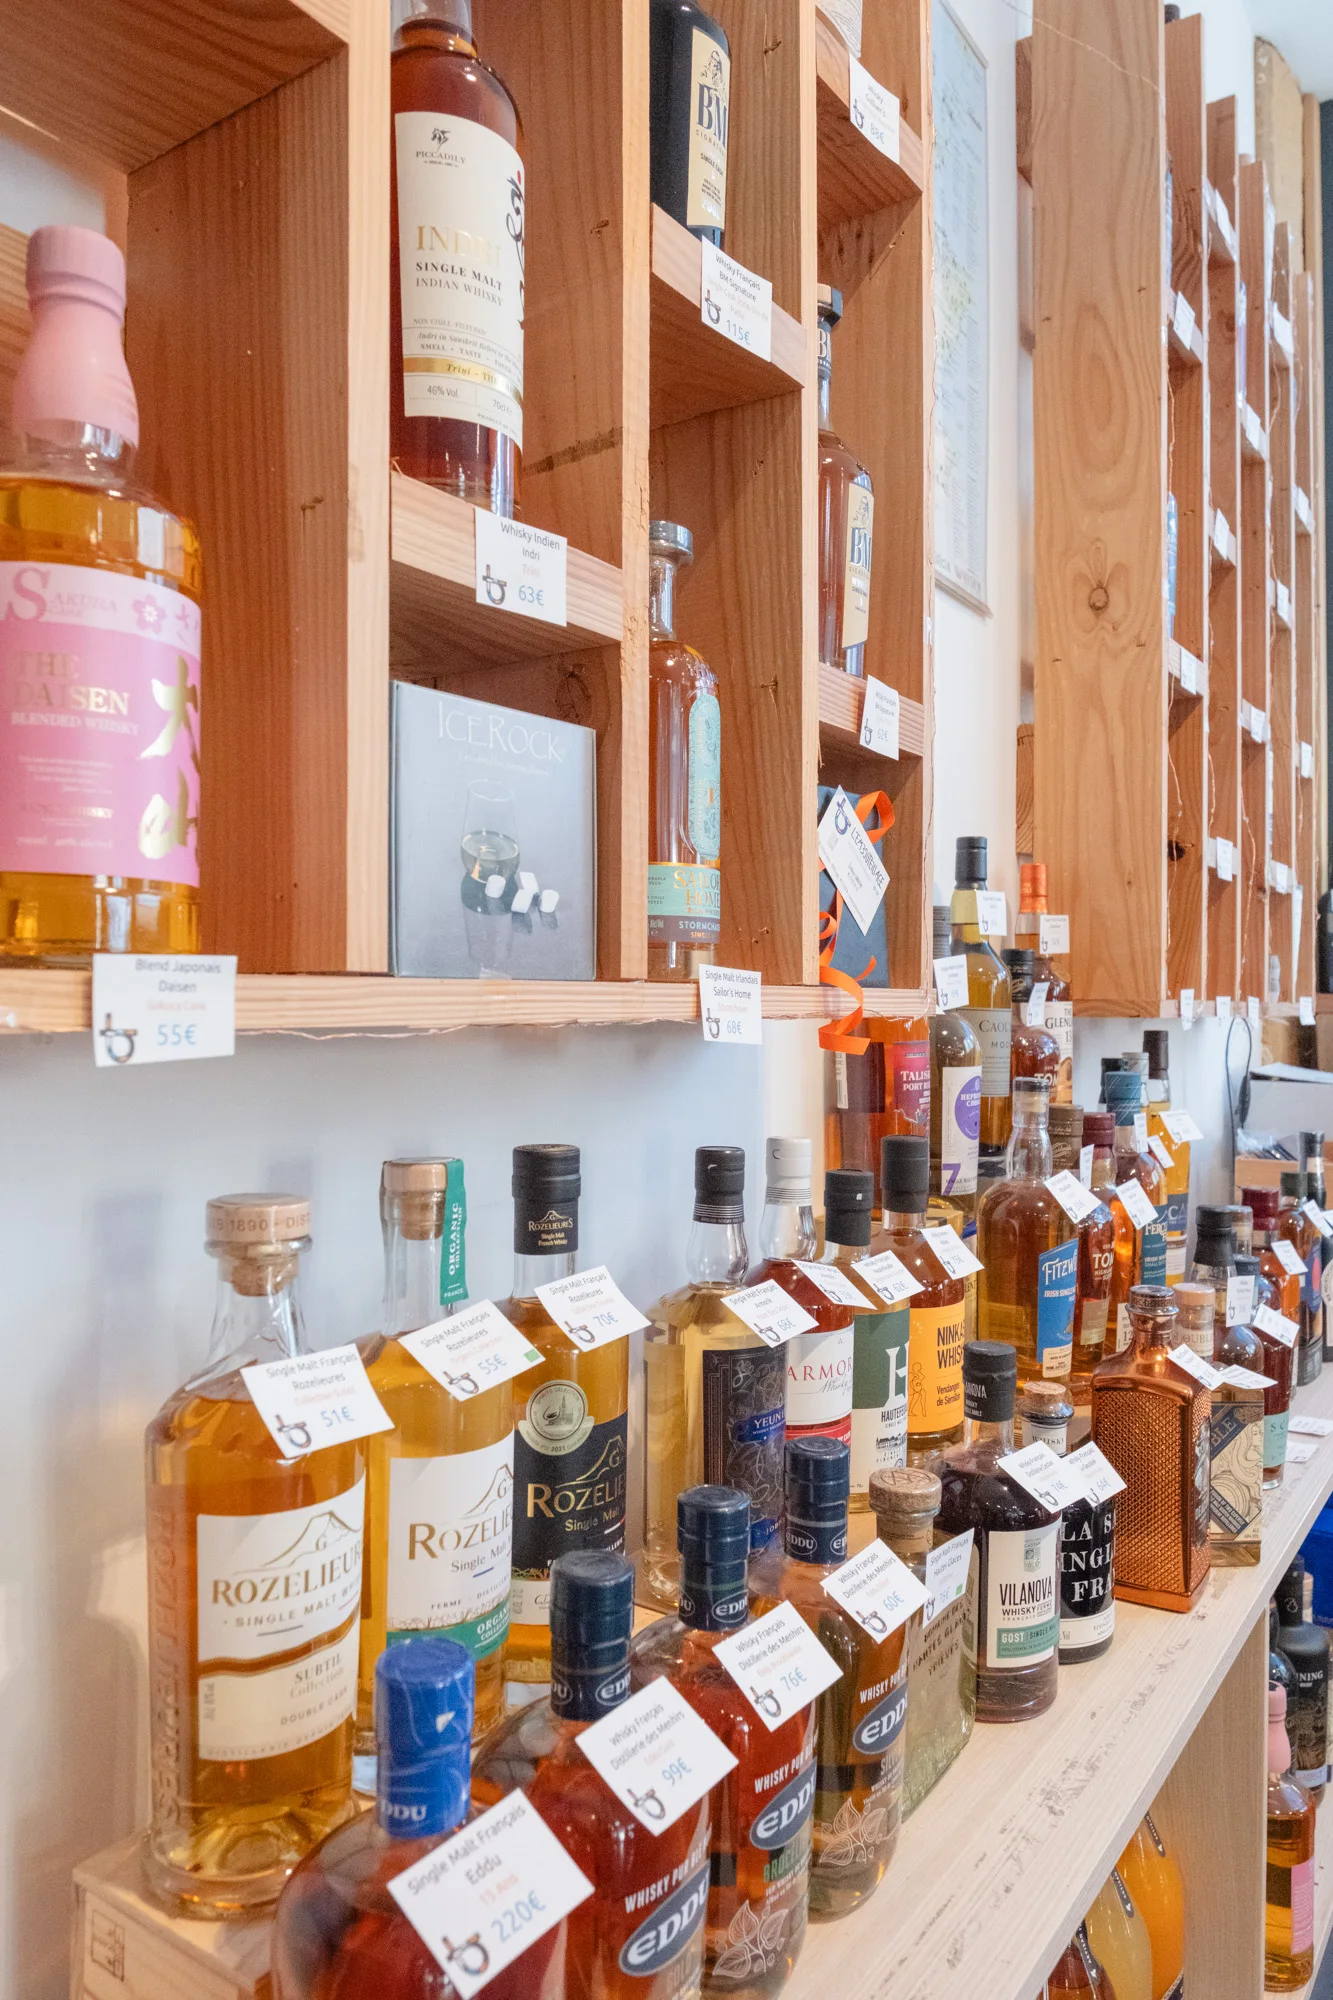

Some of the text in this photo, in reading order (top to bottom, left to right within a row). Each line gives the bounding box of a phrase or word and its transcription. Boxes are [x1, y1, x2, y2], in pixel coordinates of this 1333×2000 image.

[697, 82, 728, 148] BM
[415, 151, 466, 164] PICCADILY
[416, 262, 503, 291] SINGLE MALT
[715, 253, 761, 291] Whisky Français
[416, 278, 503, 307] INDIAN WHISKY
[720, 271, 757, 302] BM Signature
[726, 319, 750, 345] 115€
[427, 385, 445, 396] 46%
[501, 521, 560, 550] Whisky Indien
[522, 547, 540, 560] Indri
[518, 585, 544, 606] 63€
[14, 681, 130, 717] DAISEN
[136, 958, 222, 976] Blend Japonais
[705, 970, 759, 985] Single Malt Irlandais
[158, 980, 197, 993] Daisen
[713, 987, 752, 999] Sailor's Home
[157, 1023, 197, 1046] 55€
[726, 1020, 743, 1035] 68€
[941, 1163, 961, 1197] 7
[230, 1218, 268, 1233] 1890
[528, 1217, 574, 1231] ROZELIEURES
[448, 1202, 459, 1276] ORGANIC
[549, 1273, 607, 1296] Single Malt Français
[568, 1289, 604, 1303] Rozelieures
[421, 1311, 490, 1348] Single Malt Français
[593, 1312, 618, 1327] 70€
[777, 1318, 797, 1331] 68€
[446, 1328, 489, 1352] Rozelieures
[266, 1353, 358, 1380] Single Malt Français
[478, 1354, 507, 1375] 55€
[292, 1373, 346, 1391] Rozelieures
[320, 1406, 355, 1427] 51€
[565, 1516, 599, 1532] Single
[451, 1542, 506, 1573] Single Malt
[838, 1553, 879, 1585] Whisky Français
[843, 1557, 896, 1600] Distillerie des Menhirs
[999, 1576, 1053, 1606] VILANOVA
[235, 1594, 336, 1627] SINGLE MALT
[431, 1599, 462, 1610] FERME
[883, 1591, 904, 1612] 60€
[1002, 1605, 1036, 1616] WHISKY
[735, 1619, 786, 1653] Whisky Français
[1002, 1627, 1049, 1643] GOST SINGLE
[738, 1625, 806, 1672] Distillerie des Menhirs
[294, 1653, 342, 1684] SUBTIL
[780, 1667, 807, 1692] 76€
[290, 1668, 344, 1699] Collection
[859, 1680, 889, 1704] WHISKY
[280, 1701, 324, 1726] DOUBLE
[609, 1703, 664, 1746] Whisky Français
[610, 1710, 685, 1771] Distillerie des Menhirs
[662, 1757, 692, 1787] 99€
[754, 1763, 789, 1794] WHISKY
[407, 1804, 526, 1895] Single Malt Français
[465, 1853, 503, 1886] Eddu
[624, 1875, 670, 1914] WHISKY
[491, 1889, 546, 1943] 220€
